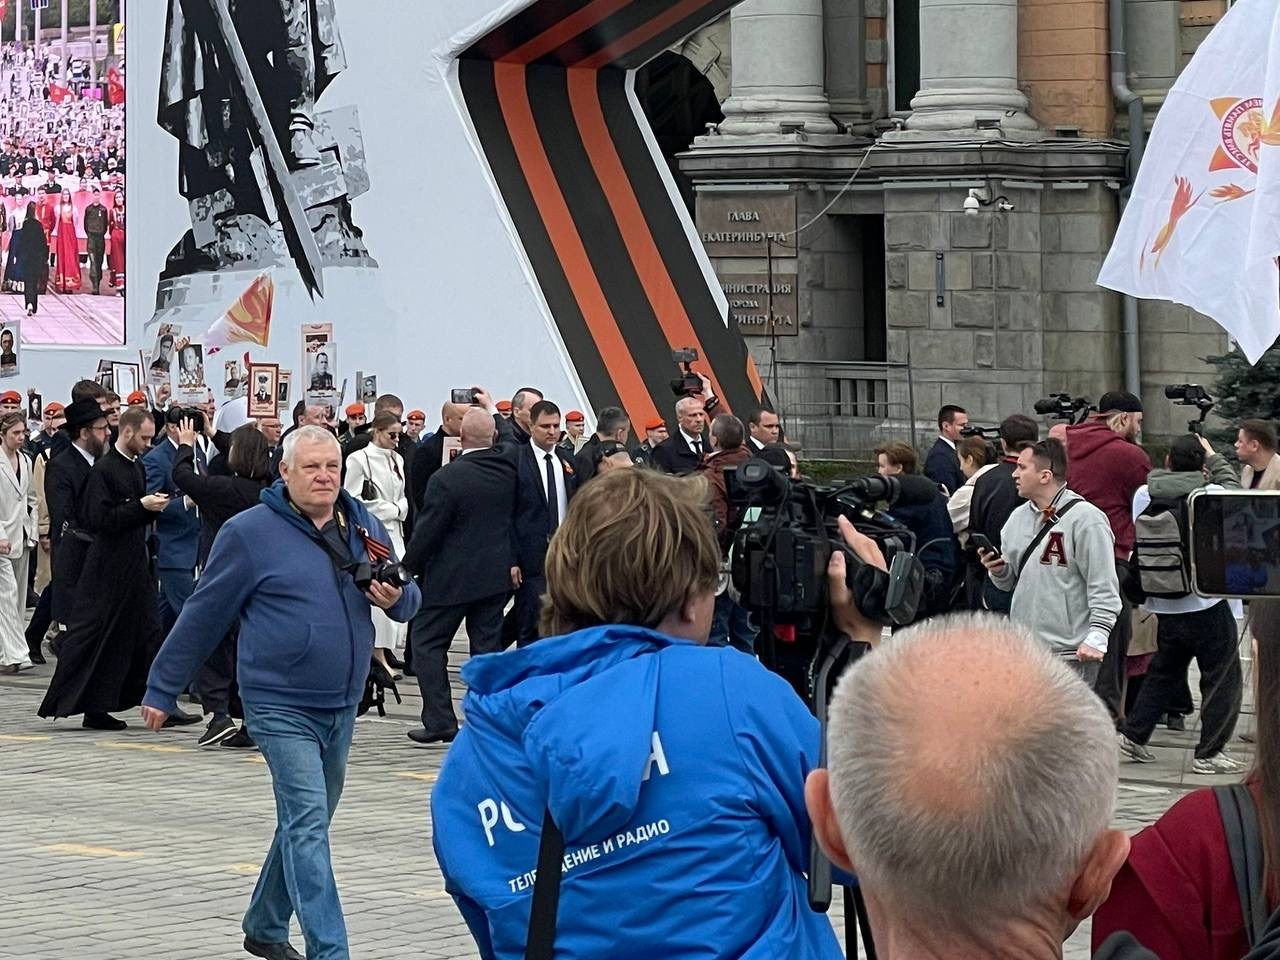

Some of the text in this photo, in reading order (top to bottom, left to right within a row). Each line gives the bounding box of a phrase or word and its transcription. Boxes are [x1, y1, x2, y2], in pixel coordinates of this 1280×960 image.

[727, 211, 761, 222] ГЛАВА
[603, 838, 614, 854] И
[616, 819, 670, 848] РАДИО
